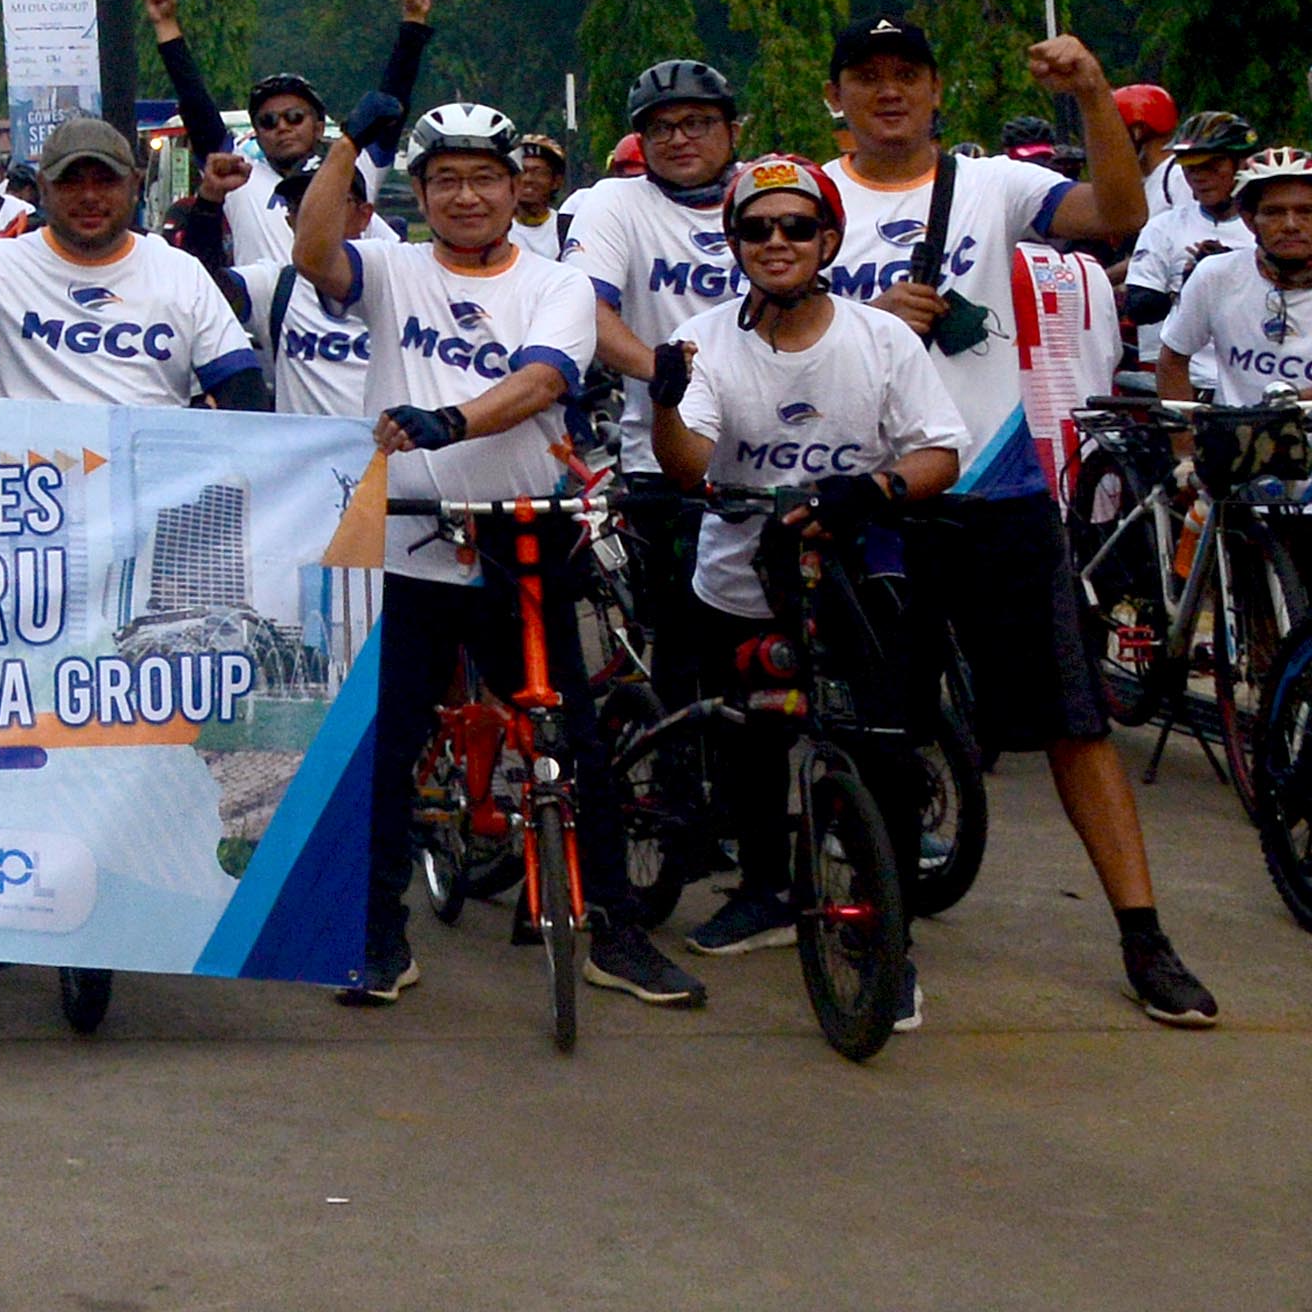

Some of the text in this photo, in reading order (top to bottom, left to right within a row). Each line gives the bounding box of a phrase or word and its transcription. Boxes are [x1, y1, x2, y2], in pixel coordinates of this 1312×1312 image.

[28, 108, 64, 125] GOWES
[649, 258, 750, 297] MGC
[831, 235, 976, 300] MGC
[21, 311, 175, 361] MGCC
[285, 328, 371, 362] MGC
[400, 316, 524, 379] MGC
[736, 440, 862, 473] MGCC
[57, 653, 254, 725] GROUP
